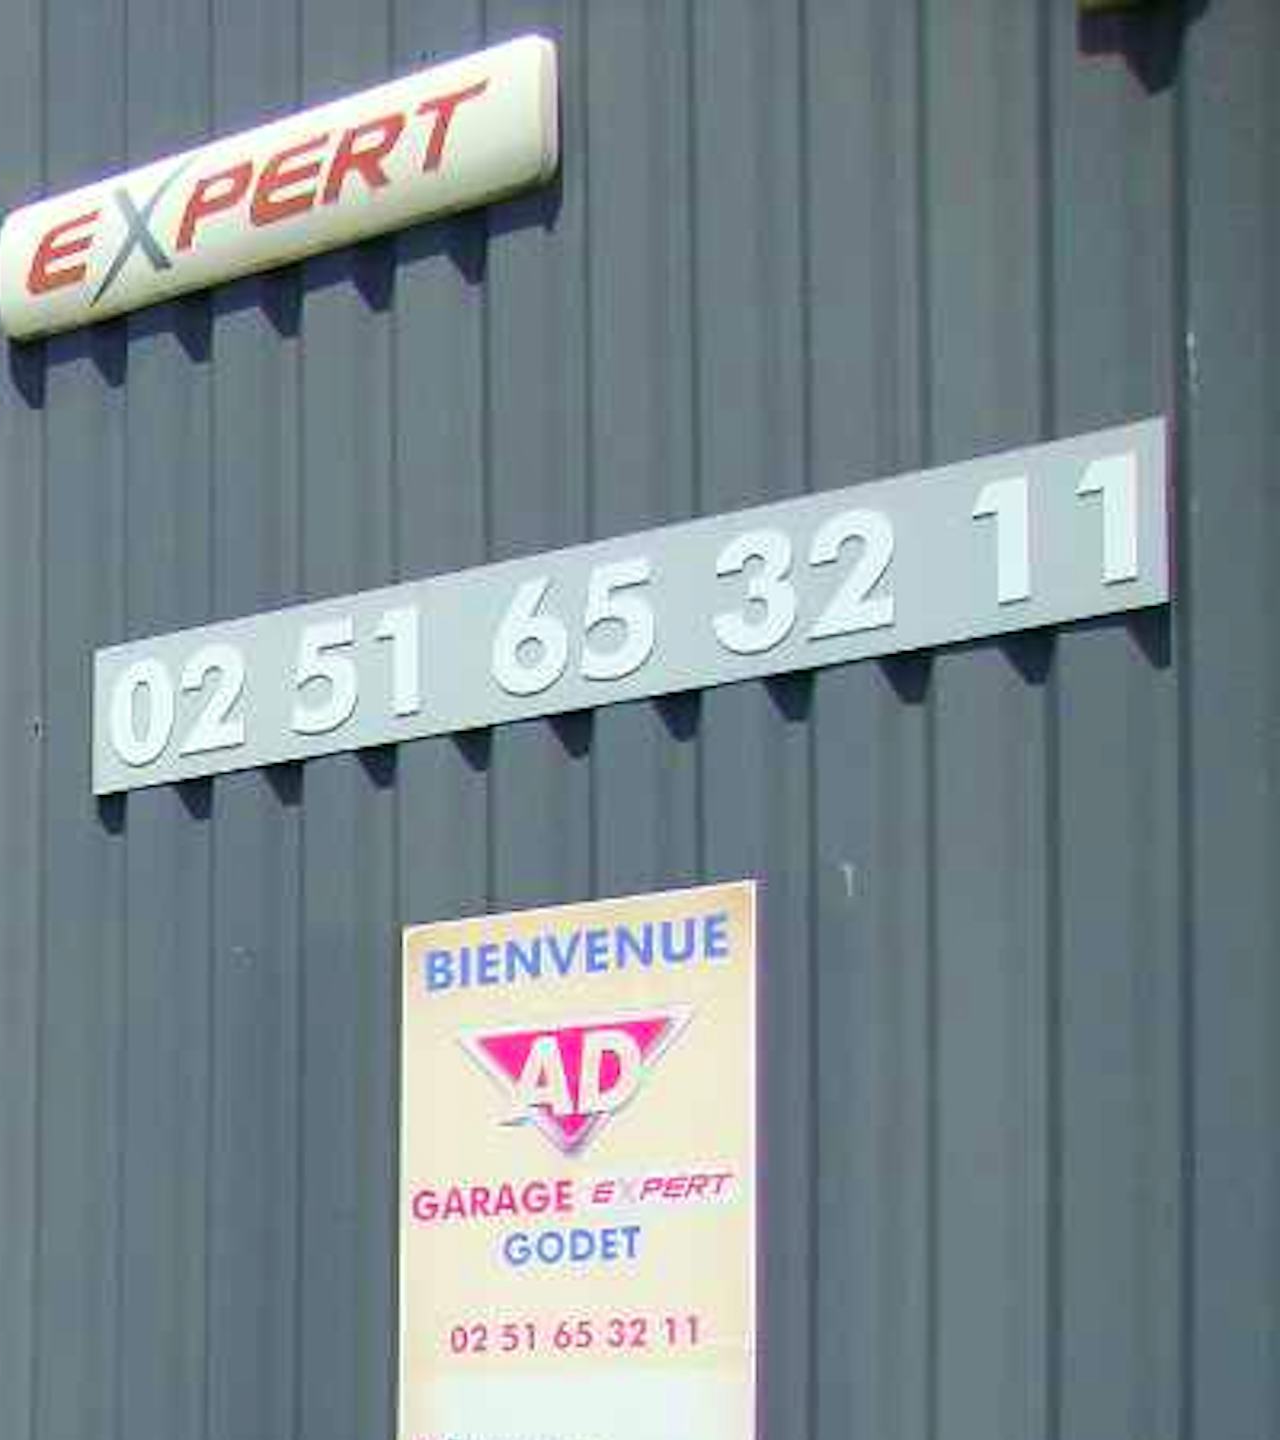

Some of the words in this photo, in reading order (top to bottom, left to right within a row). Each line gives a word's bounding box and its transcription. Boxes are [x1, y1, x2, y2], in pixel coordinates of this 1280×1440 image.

[26, 80, 487, 307] EXPERT
[109, 643, 246, 766] 02
[288, 605, 420, 735] 51
[490, 557, 655, 696] 65
[713, 509, 896, 655] 32
[972, 453, 1140, 604] 11
[425, 914, 730, 992] BIENVENUE
[506, 1028, 643, 1120] AD
[412, 1178, 574, 1221] GARAGE
[503, 1225, 641, 1266] GODET
[450, 1323, 488, 1353] 02
[501, 1323, 537, 1351] 51
[553, 1320, 594, 1349] 65
[607, 1317, 648, 1347] 32
[664, 1315, 700, 1346] 11
